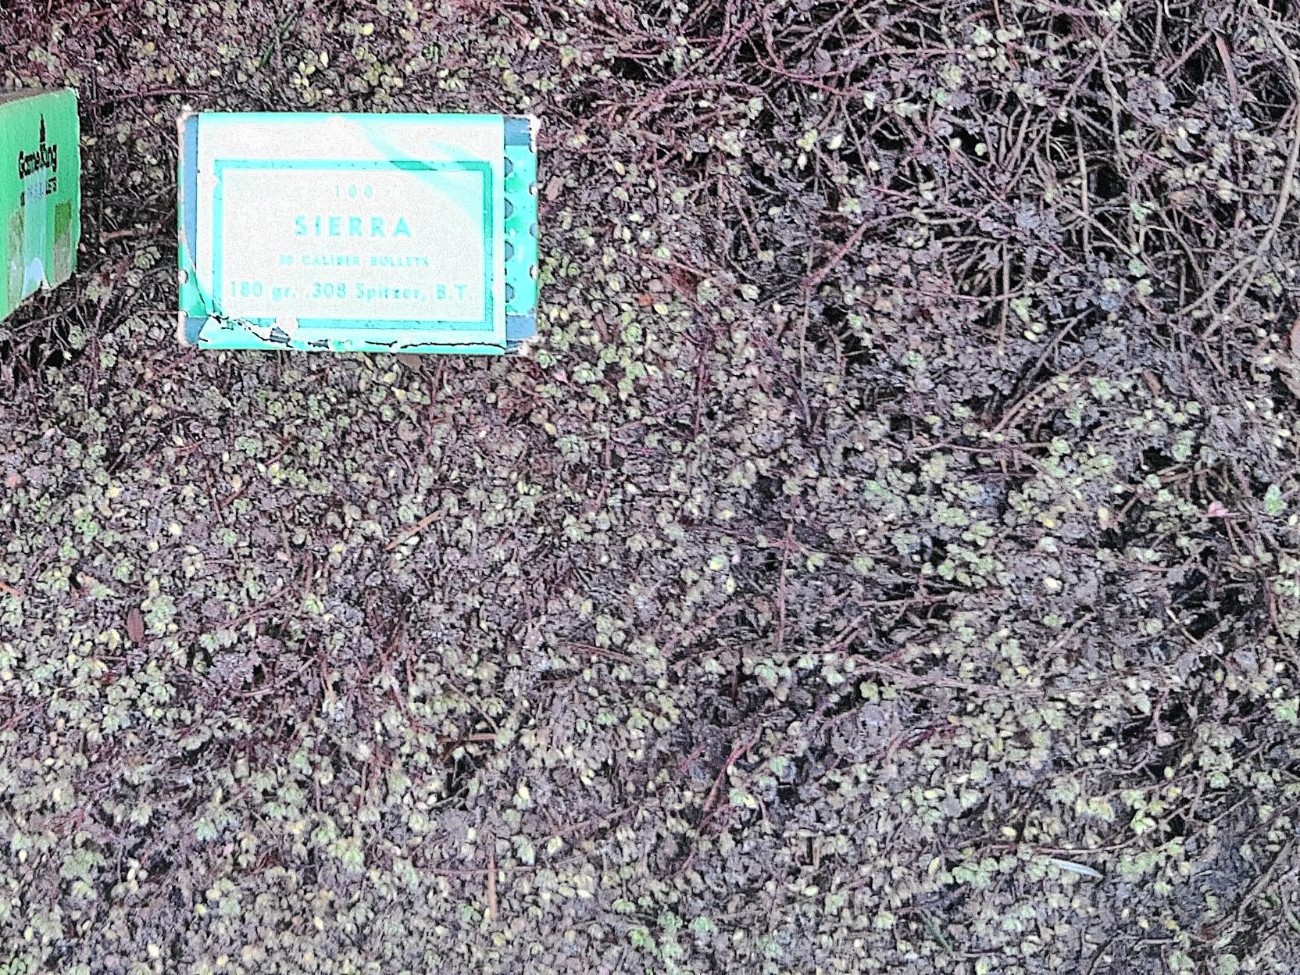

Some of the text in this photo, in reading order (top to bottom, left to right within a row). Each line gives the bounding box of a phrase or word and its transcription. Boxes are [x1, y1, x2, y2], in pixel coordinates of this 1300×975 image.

[334, 183, 373, 199] 100
[293, 214, 412, 238] SIERRA
[230, 280, 263, 297] 180
